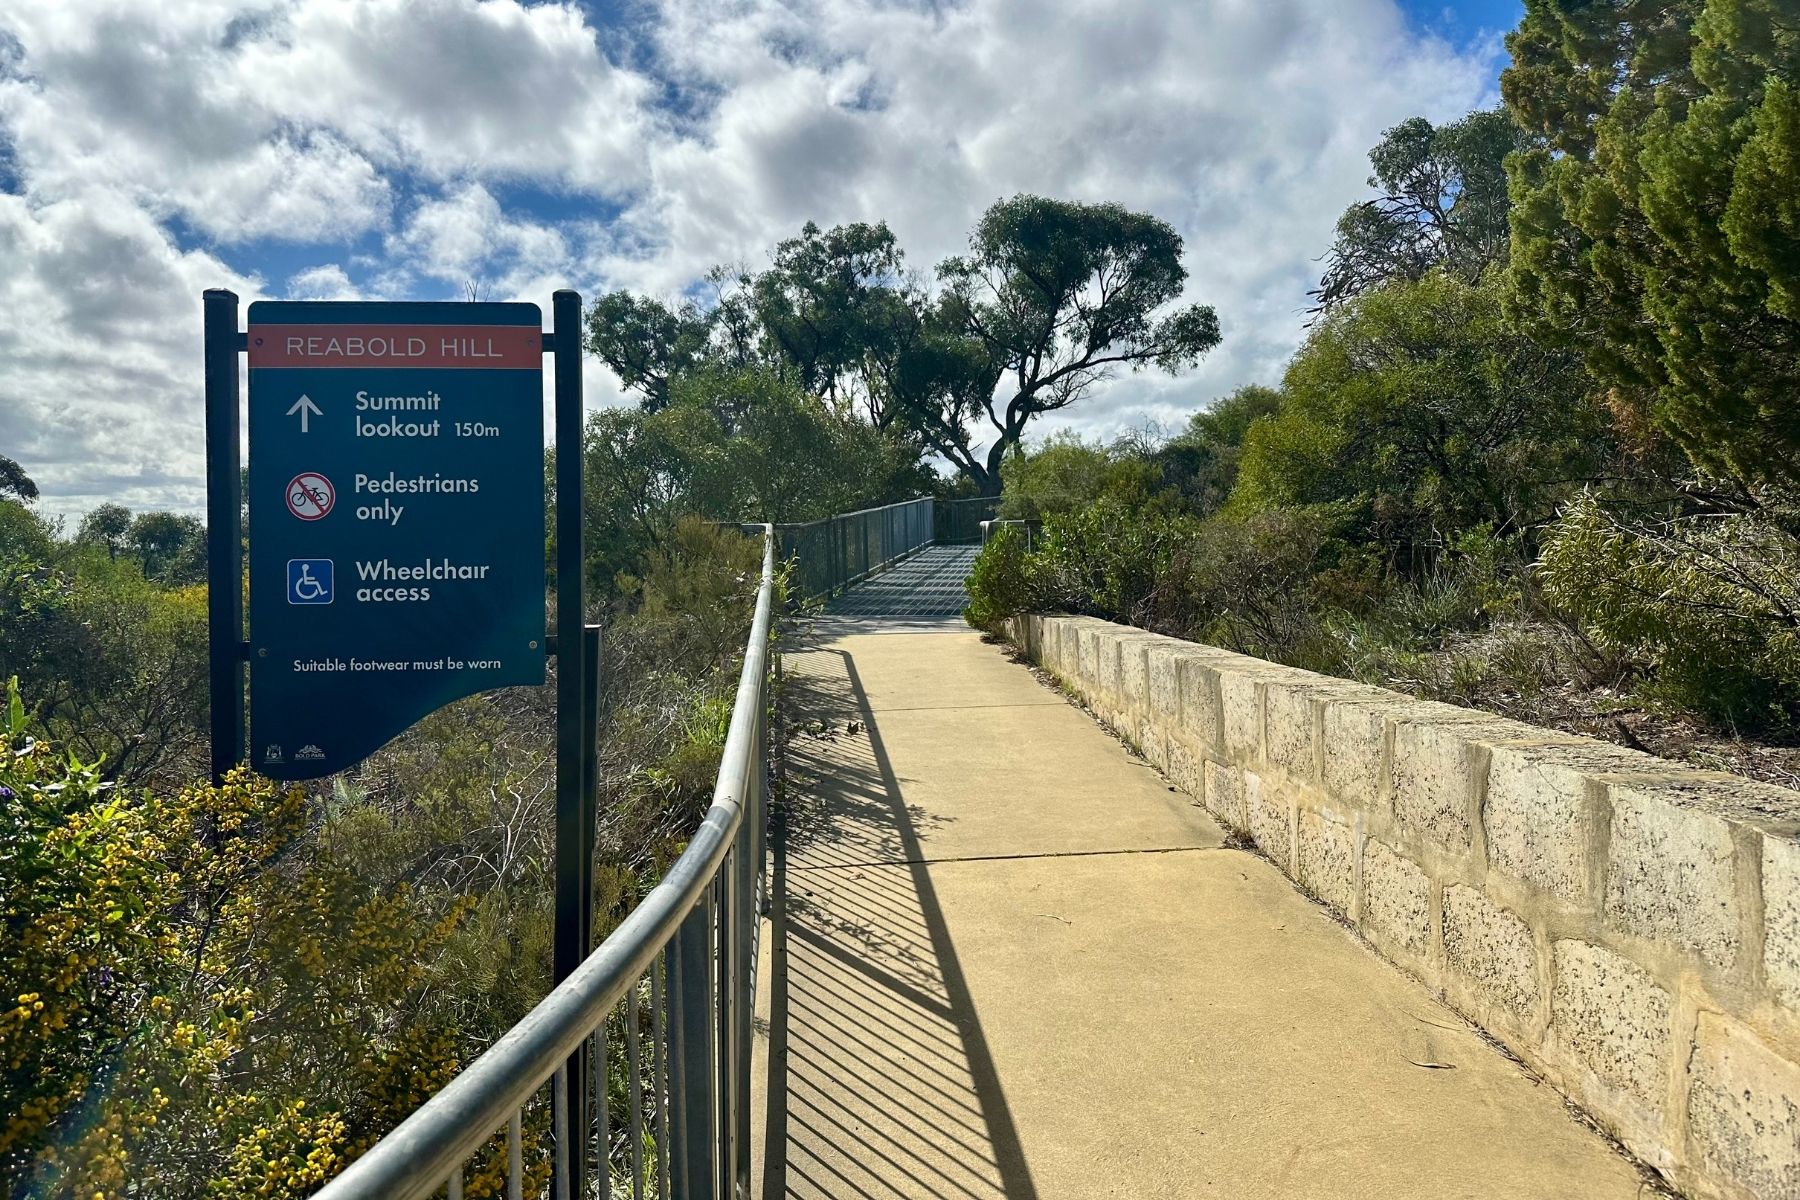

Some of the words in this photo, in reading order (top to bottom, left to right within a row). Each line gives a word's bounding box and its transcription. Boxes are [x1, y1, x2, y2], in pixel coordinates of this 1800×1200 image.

[287, 337, 426, 357] REABOLD
[441, 338, 504, 357] HILL
[356, 390, 441, 411] Summit
[356, 415, 441, 437] lookout
[454, 422, 500, 437] 150m
[355, 472, 479, 493] Pedestrians
[356, 498, 404, 525] only
[356, 558, 490, 580] Wheelchair
[356, 587, 431, 602] access
[293, 657, 347, 672] Suitable
[349, 657, 410, 671] footwear
[413, 658, 444, 670] must
[447, 656, 464, 670] be
[467, 660, 501, 670] worn
